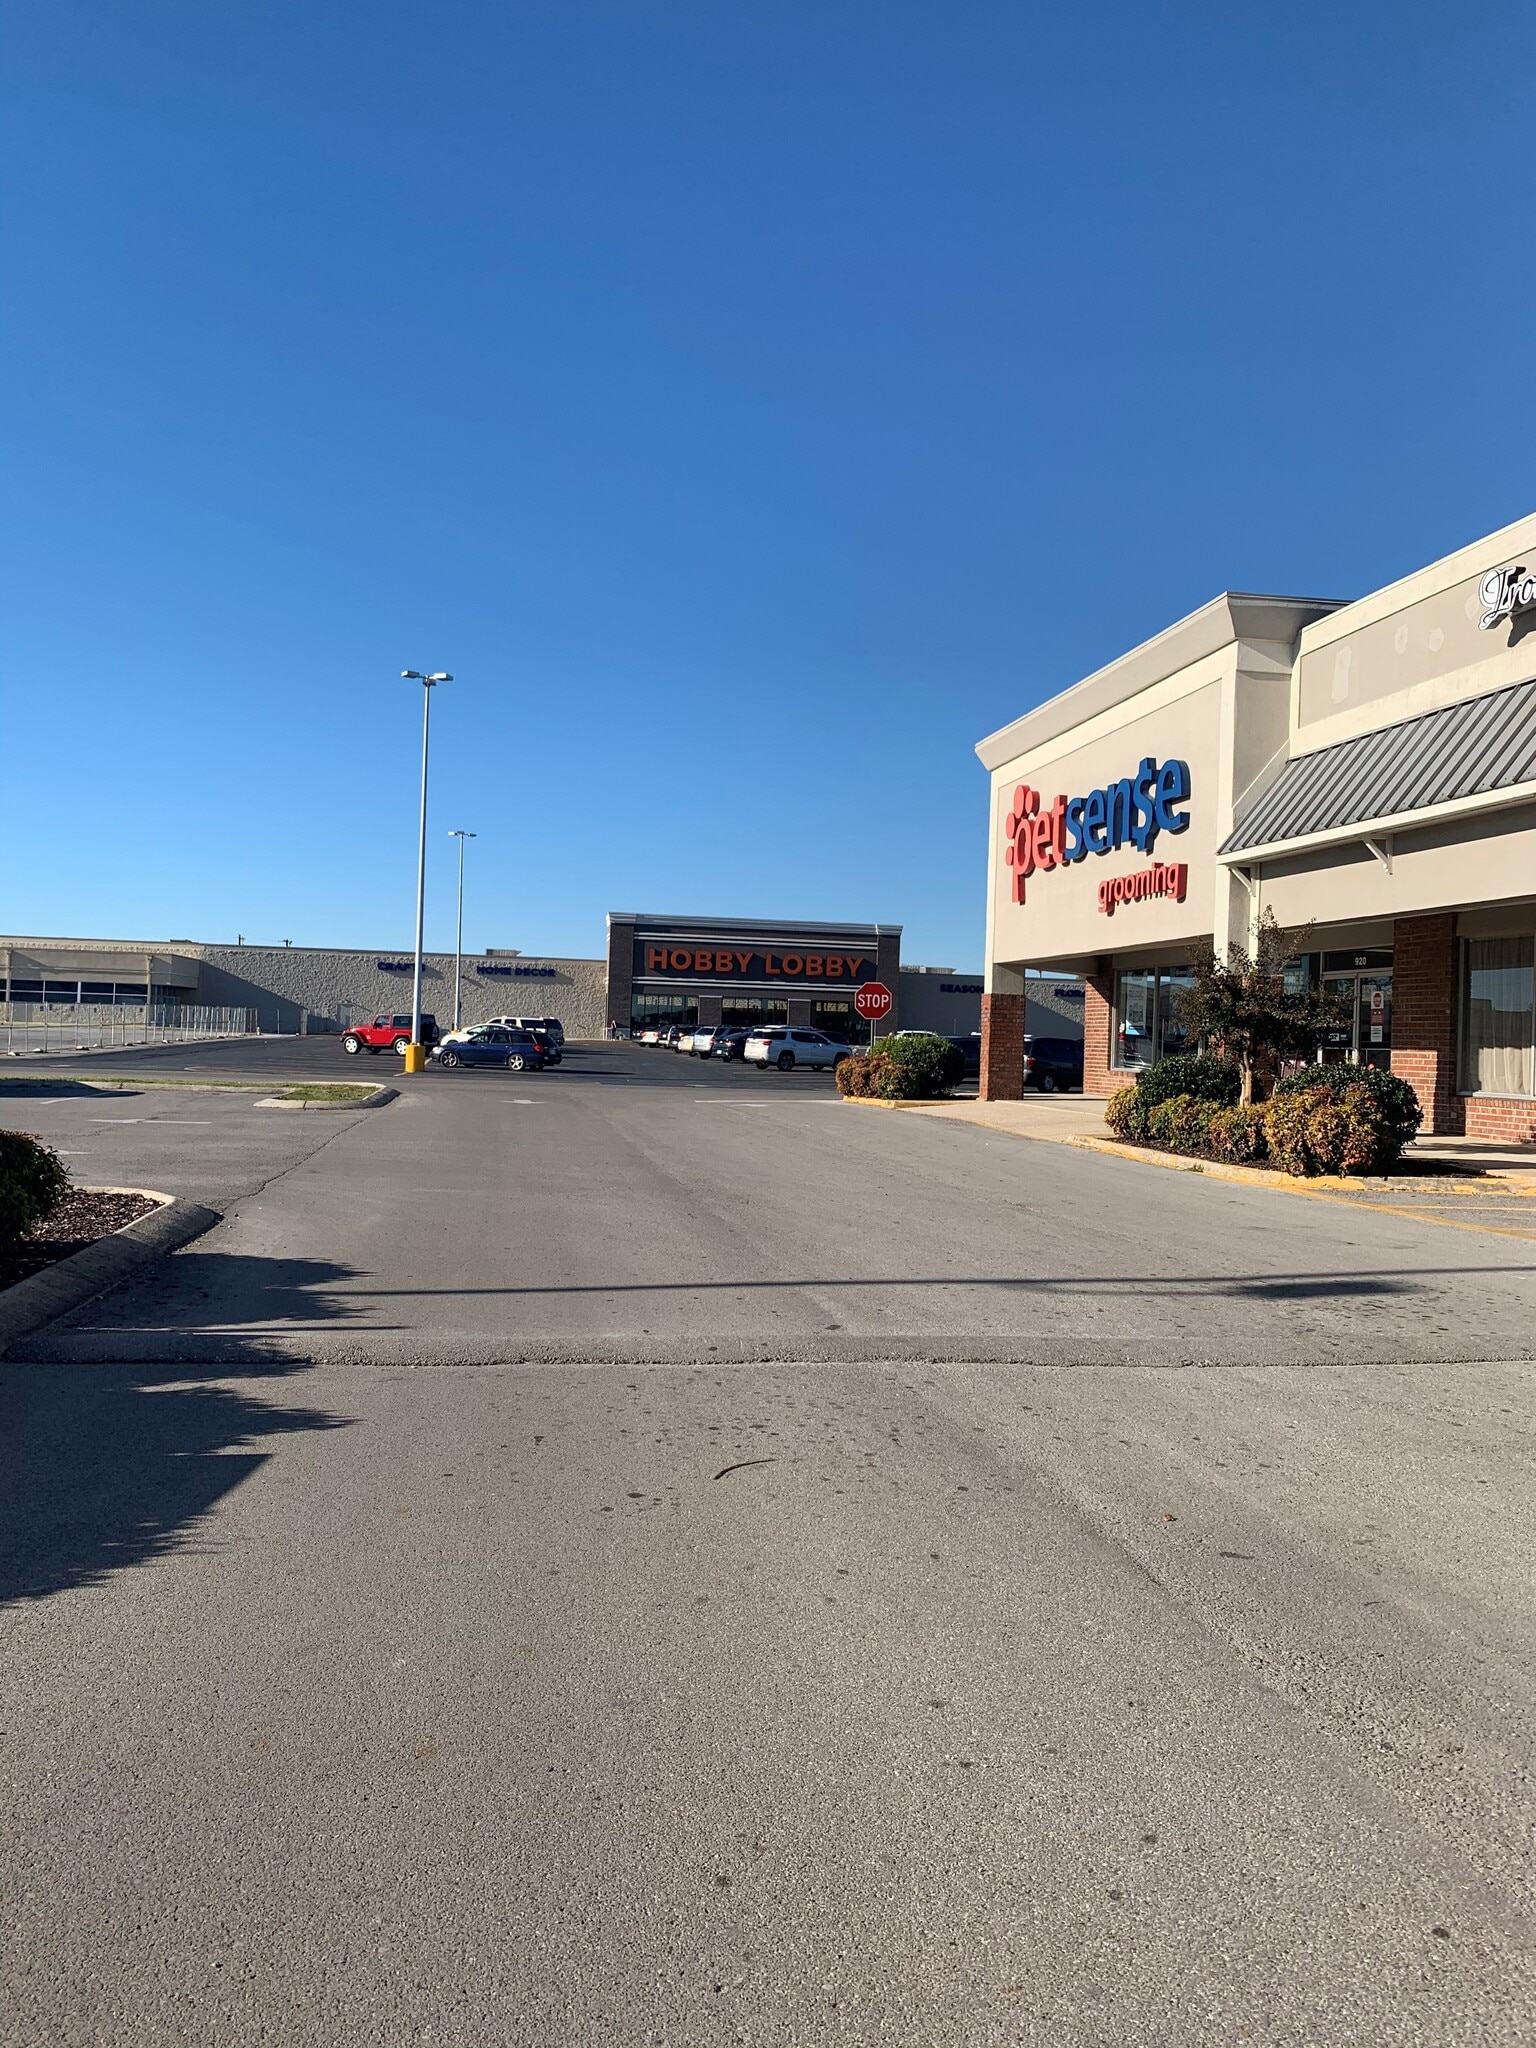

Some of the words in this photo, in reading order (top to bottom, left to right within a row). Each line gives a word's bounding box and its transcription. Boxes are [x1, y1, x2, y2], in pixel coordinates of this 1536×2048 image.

[1478, 566, 1536, 630] Iro
[1098, 862, 1188, 914] grooming
[377, 961, 426, 973] CRAFS
[649, 947, 753, 973] HOBBY
[765, 953, 863, 978] LOBBY
[1354, 957, 1367, 966] 920
[476, 965, 512, 976] HOME
[514, 967, 556, 977] DECOR
[857, 993, 889, 1008] STOP
